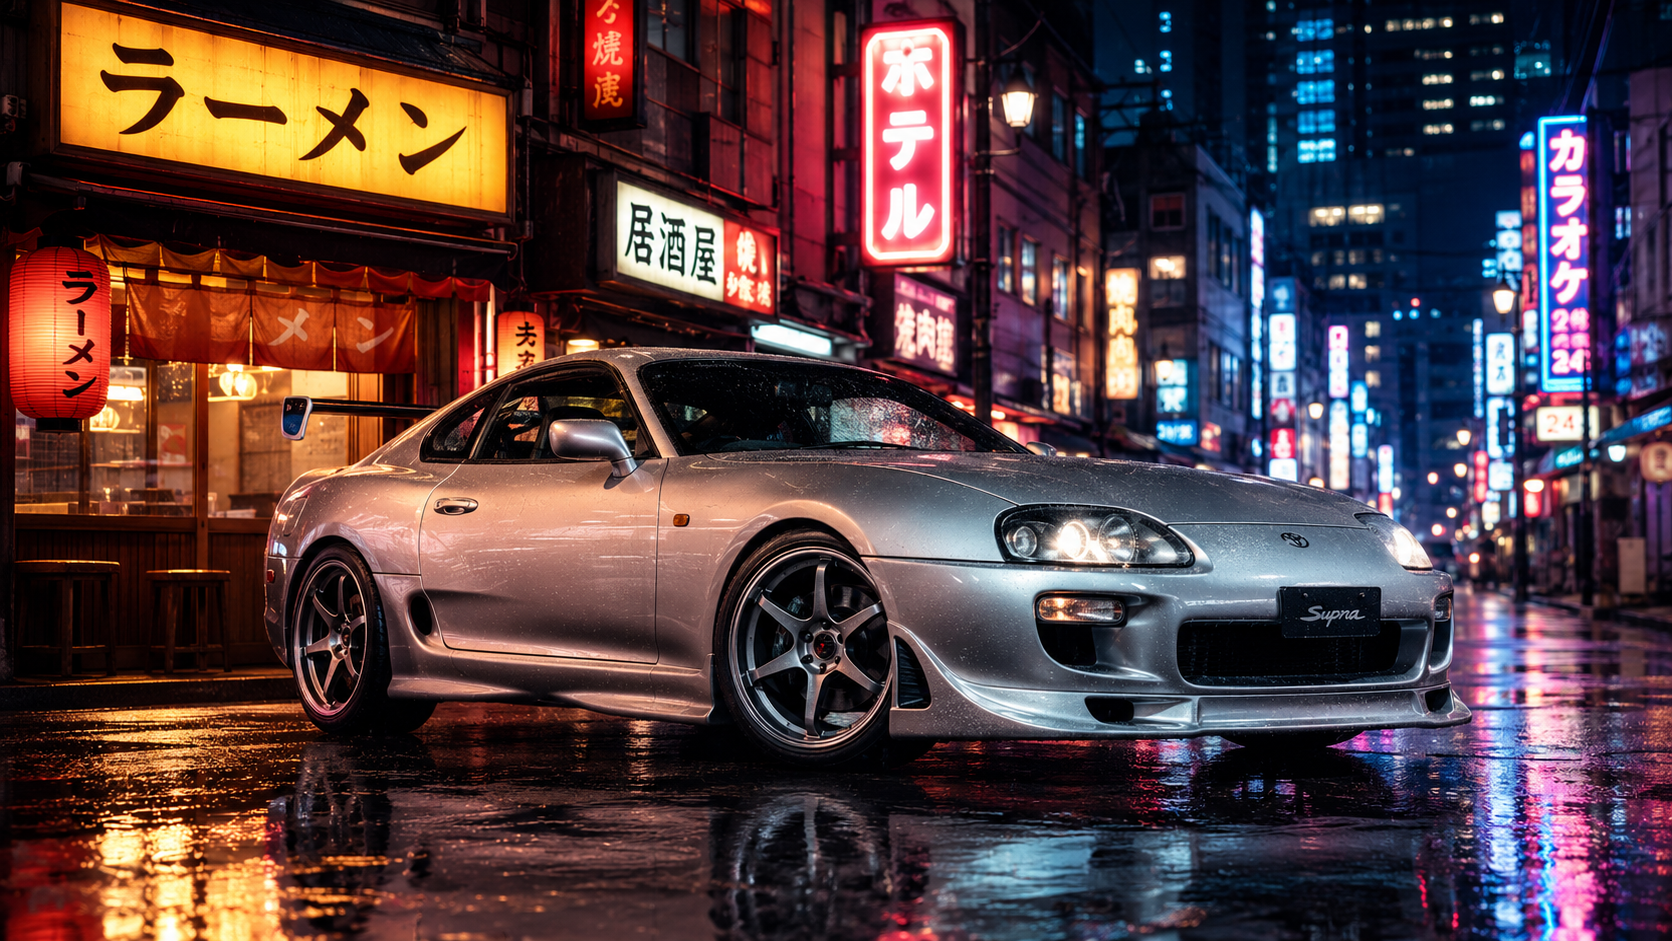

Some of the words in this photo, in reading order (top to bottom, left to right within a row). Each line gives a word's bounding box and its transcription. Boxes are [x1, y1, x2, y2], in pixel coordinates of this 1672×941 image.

[100, 42, 467, 176] ラーメン
[881, 38, 935, 240] ホテル
[624, 201, 717, 286] 居酒屋
[1549, 129, 1589, 304] カラオケ
[61, 270, 98, 399] ラーメン
[1546, 414, 1575, 434] 24
